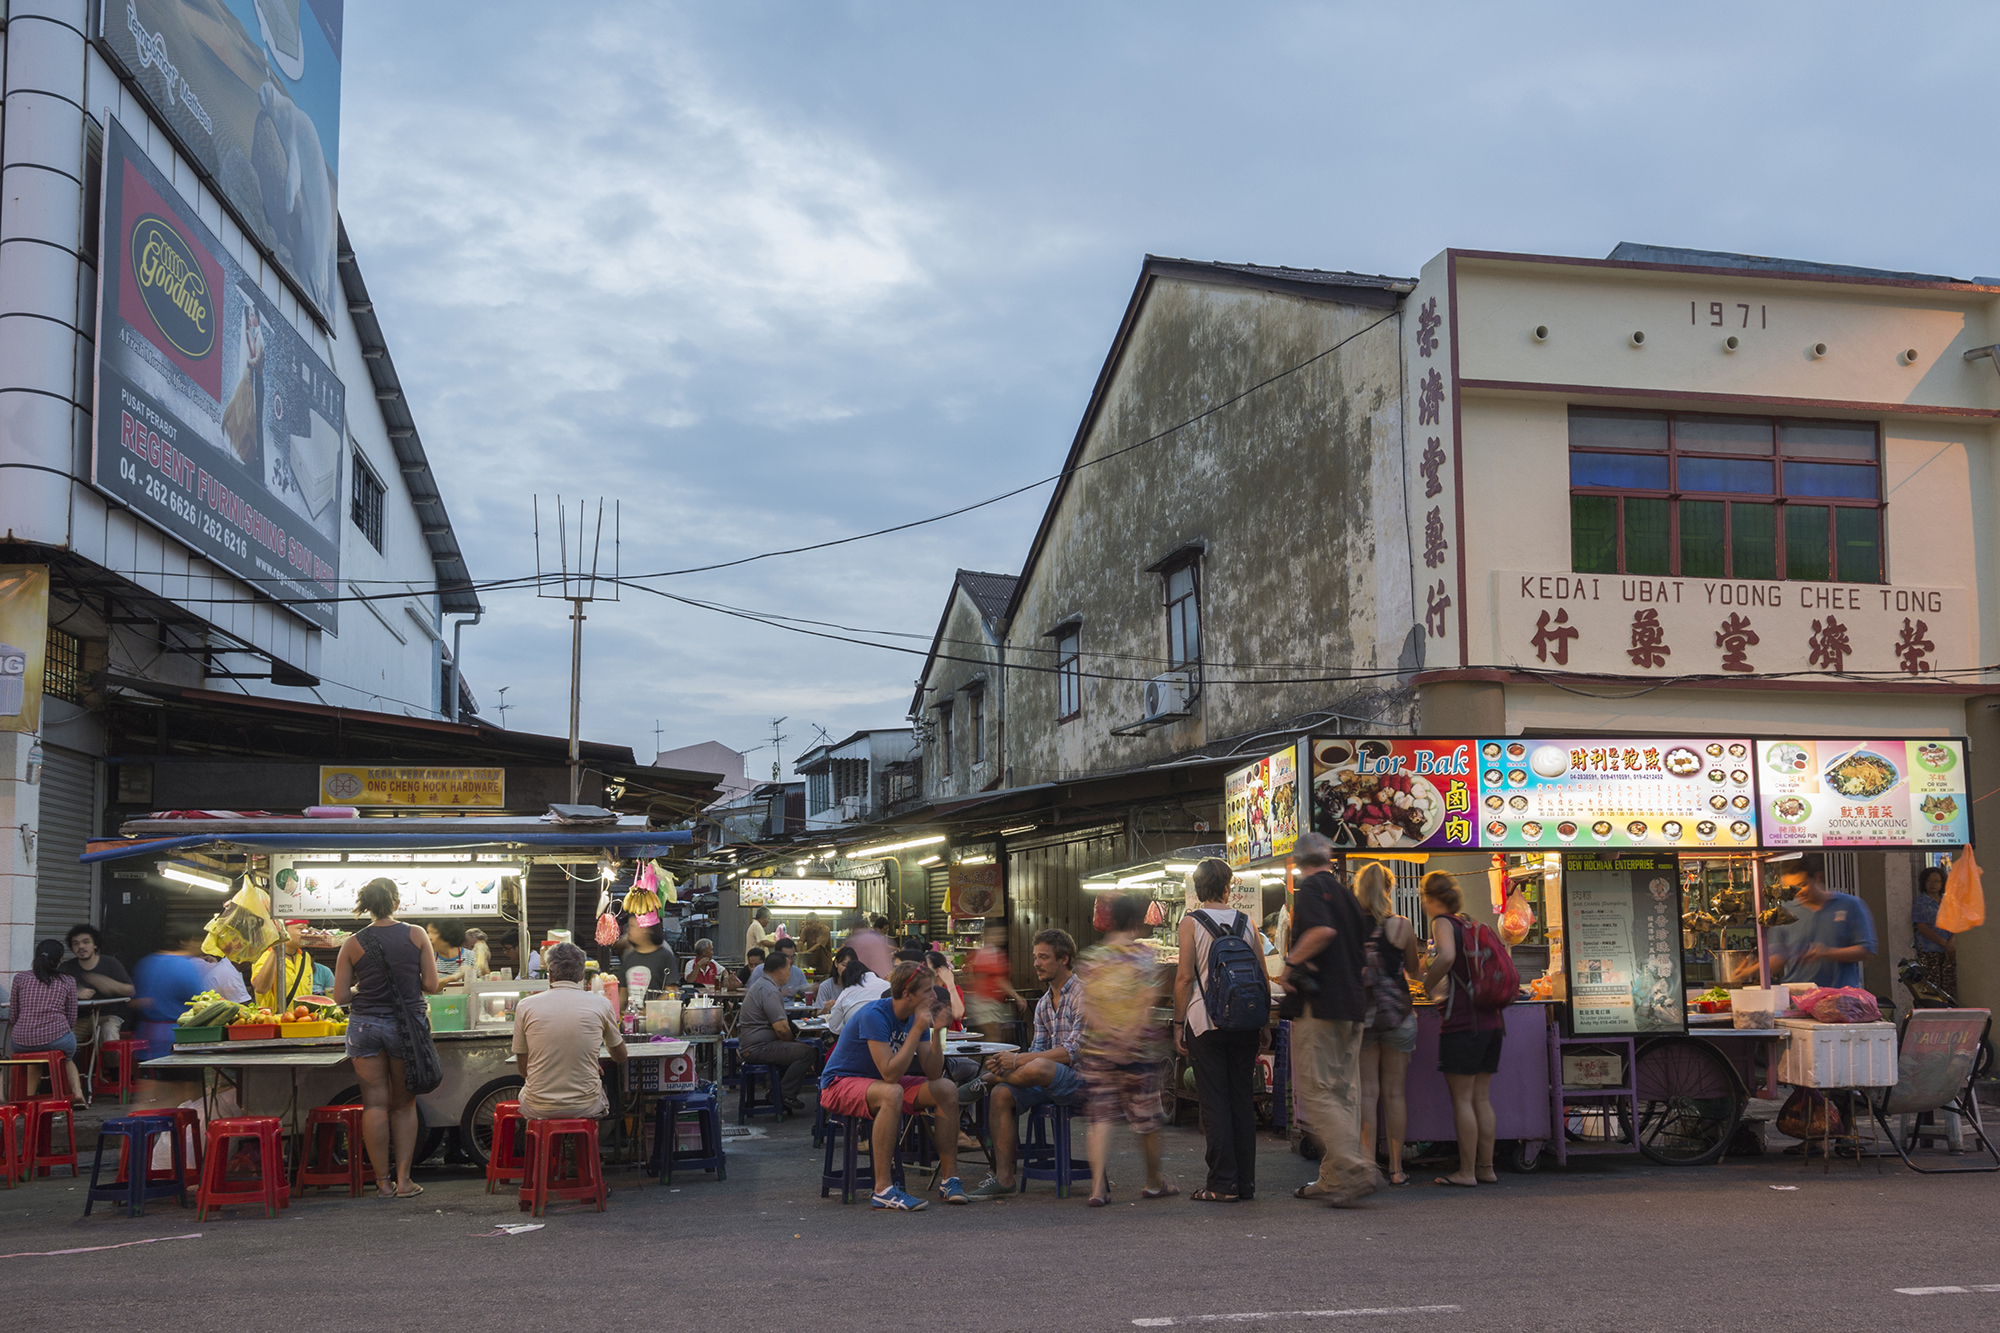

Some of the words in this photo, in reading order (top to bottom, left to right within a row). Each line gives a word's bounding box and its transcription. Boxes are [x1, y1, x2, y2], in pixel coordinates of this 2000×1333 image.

[179, 77, 213, 136] Mattress
[140, 229, 206, 334] Goodnite
[1690, 301, 1767, 329] 1971
[121, 388, 146, 417] PUSAT
[145, 407, 178, 441] PERABOT
[119, 456, 136, 482] 04
[145, 473, 168, 507] 262
[170, 486, 196, 529] 6626
[203, 514, 222, 544] 262
[223, 529, 247, 560] 6216
[121, 409, 195, 492] REGENT
[198, 467, 286, 558] FURNISHING
[288, 536, 312, 578] SDN
[313, 554, 335, 593] BHD
[255, 555, 333, 616] www.regentfurnishing.com
[1521, 576, 1600, 600] KEDAI
[1622, 579, 1684, 604] UBAT
[1704, 583, 1782, 607] YOONG
[1800, 586, 1861, 610] CHEE
[1880, 590, 1942, 613] TONG
[0, 655, 25, 675] G
[367, 769, 397, 780] KEDAI
[400, 769, 464, 781] PERKAKASAN
[467, 770, 500, 781] LOGAM
[1355, 749, 1407, 776] Lor
[1413, 744, 1471, 776] Bak
[367, 781, 387, 792] ONG
[389, 781, 420, 793] CHENG
[422, 781, 448, 793] HOCK
[450, 781, 499, 793] HARDWARE
[1828, 819, 1859, 828] SOTONG
[1860, 818, 1908, 828] KANGKUNG
[1250, 842, 1260, 860] Lor
[1260, 834, 1272, 856] Bak
[1567, 860, 1582, 871] OEW
[1614, 859, 1654, 870] ENTERPRISE
[1238, 885, 1255, 893] Fun
